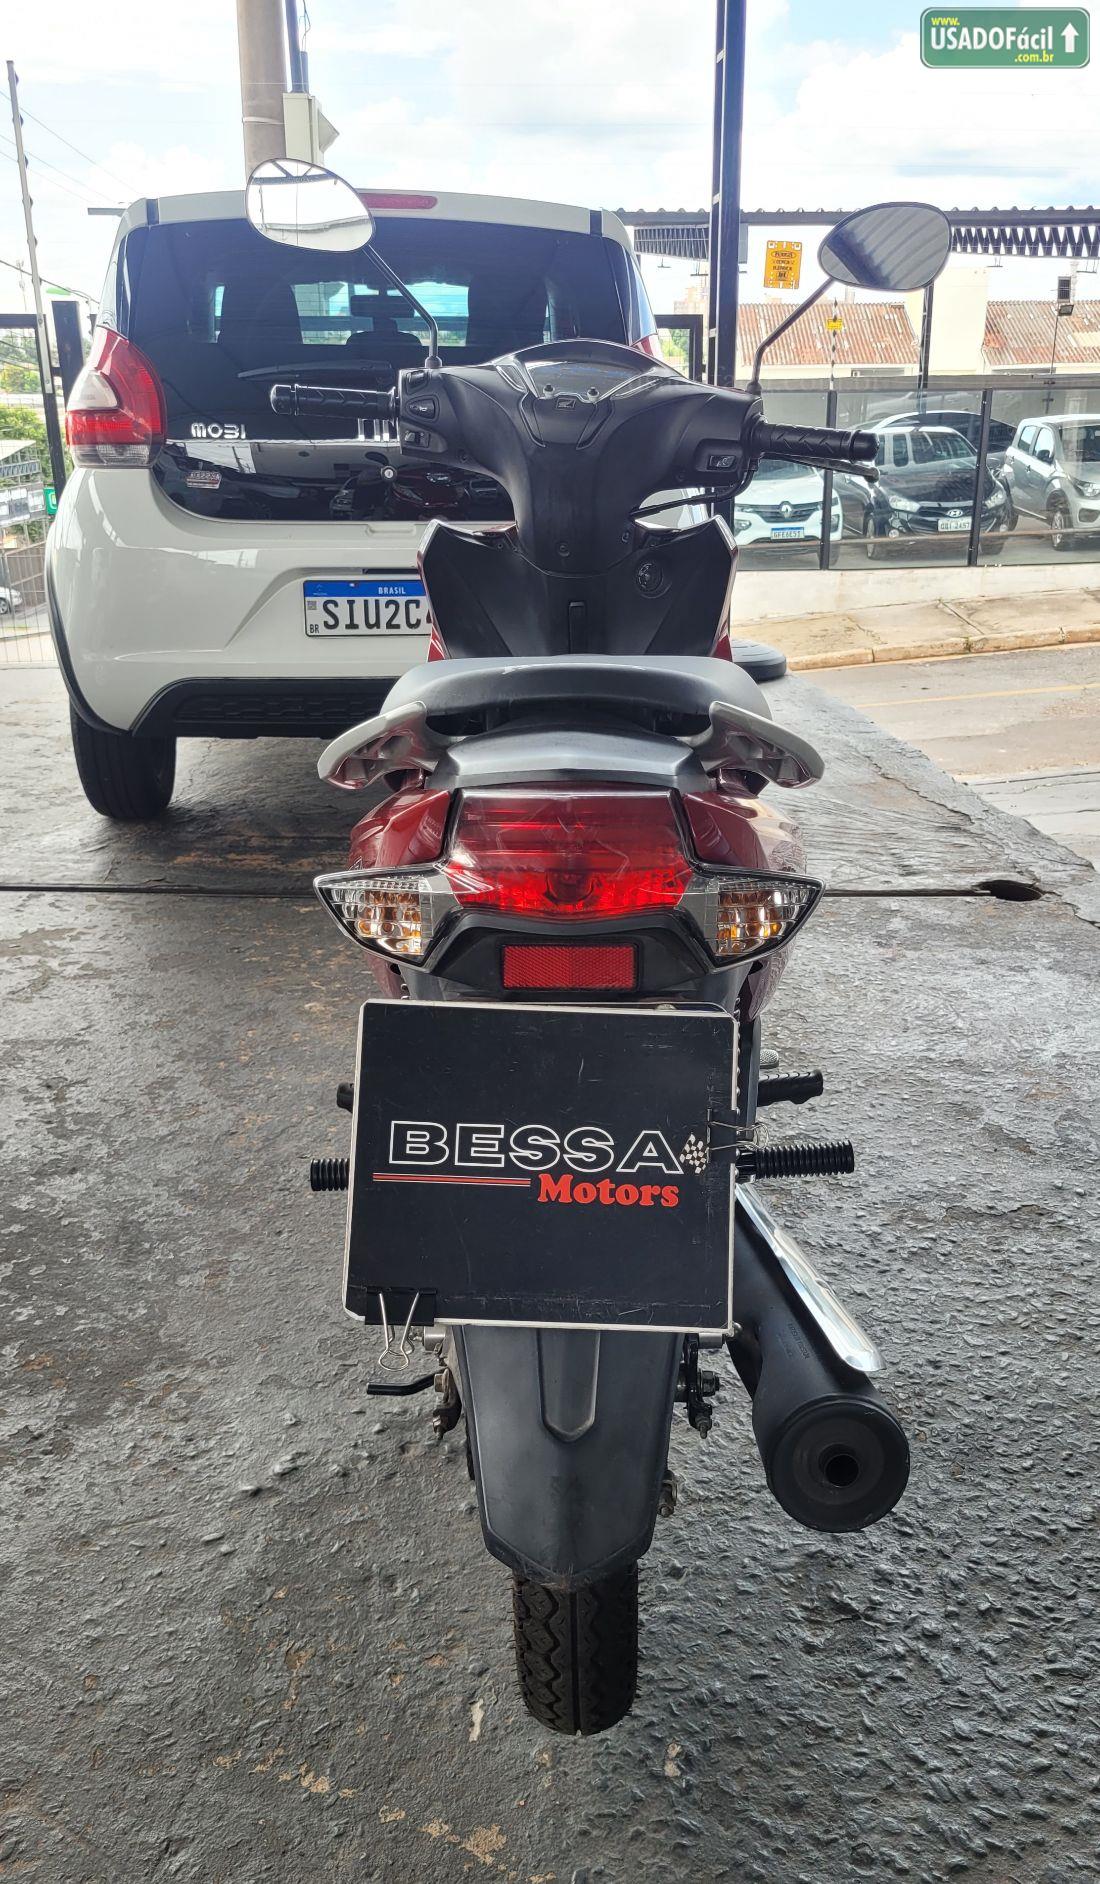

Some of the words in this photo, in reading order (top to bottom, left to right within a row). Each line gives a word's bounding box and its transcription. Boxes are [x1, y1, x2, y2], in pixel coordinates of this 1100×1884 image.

[191, 422, 246, 439] MOBI
[378, 587, 406, 595] BRASIL
[322, 599, 432, 630] SIU2C
[309, 624, 320, 634] BR
[388, 1120, 684, 1174] BESSA
[537, 1173, 679, 1207] Motors
